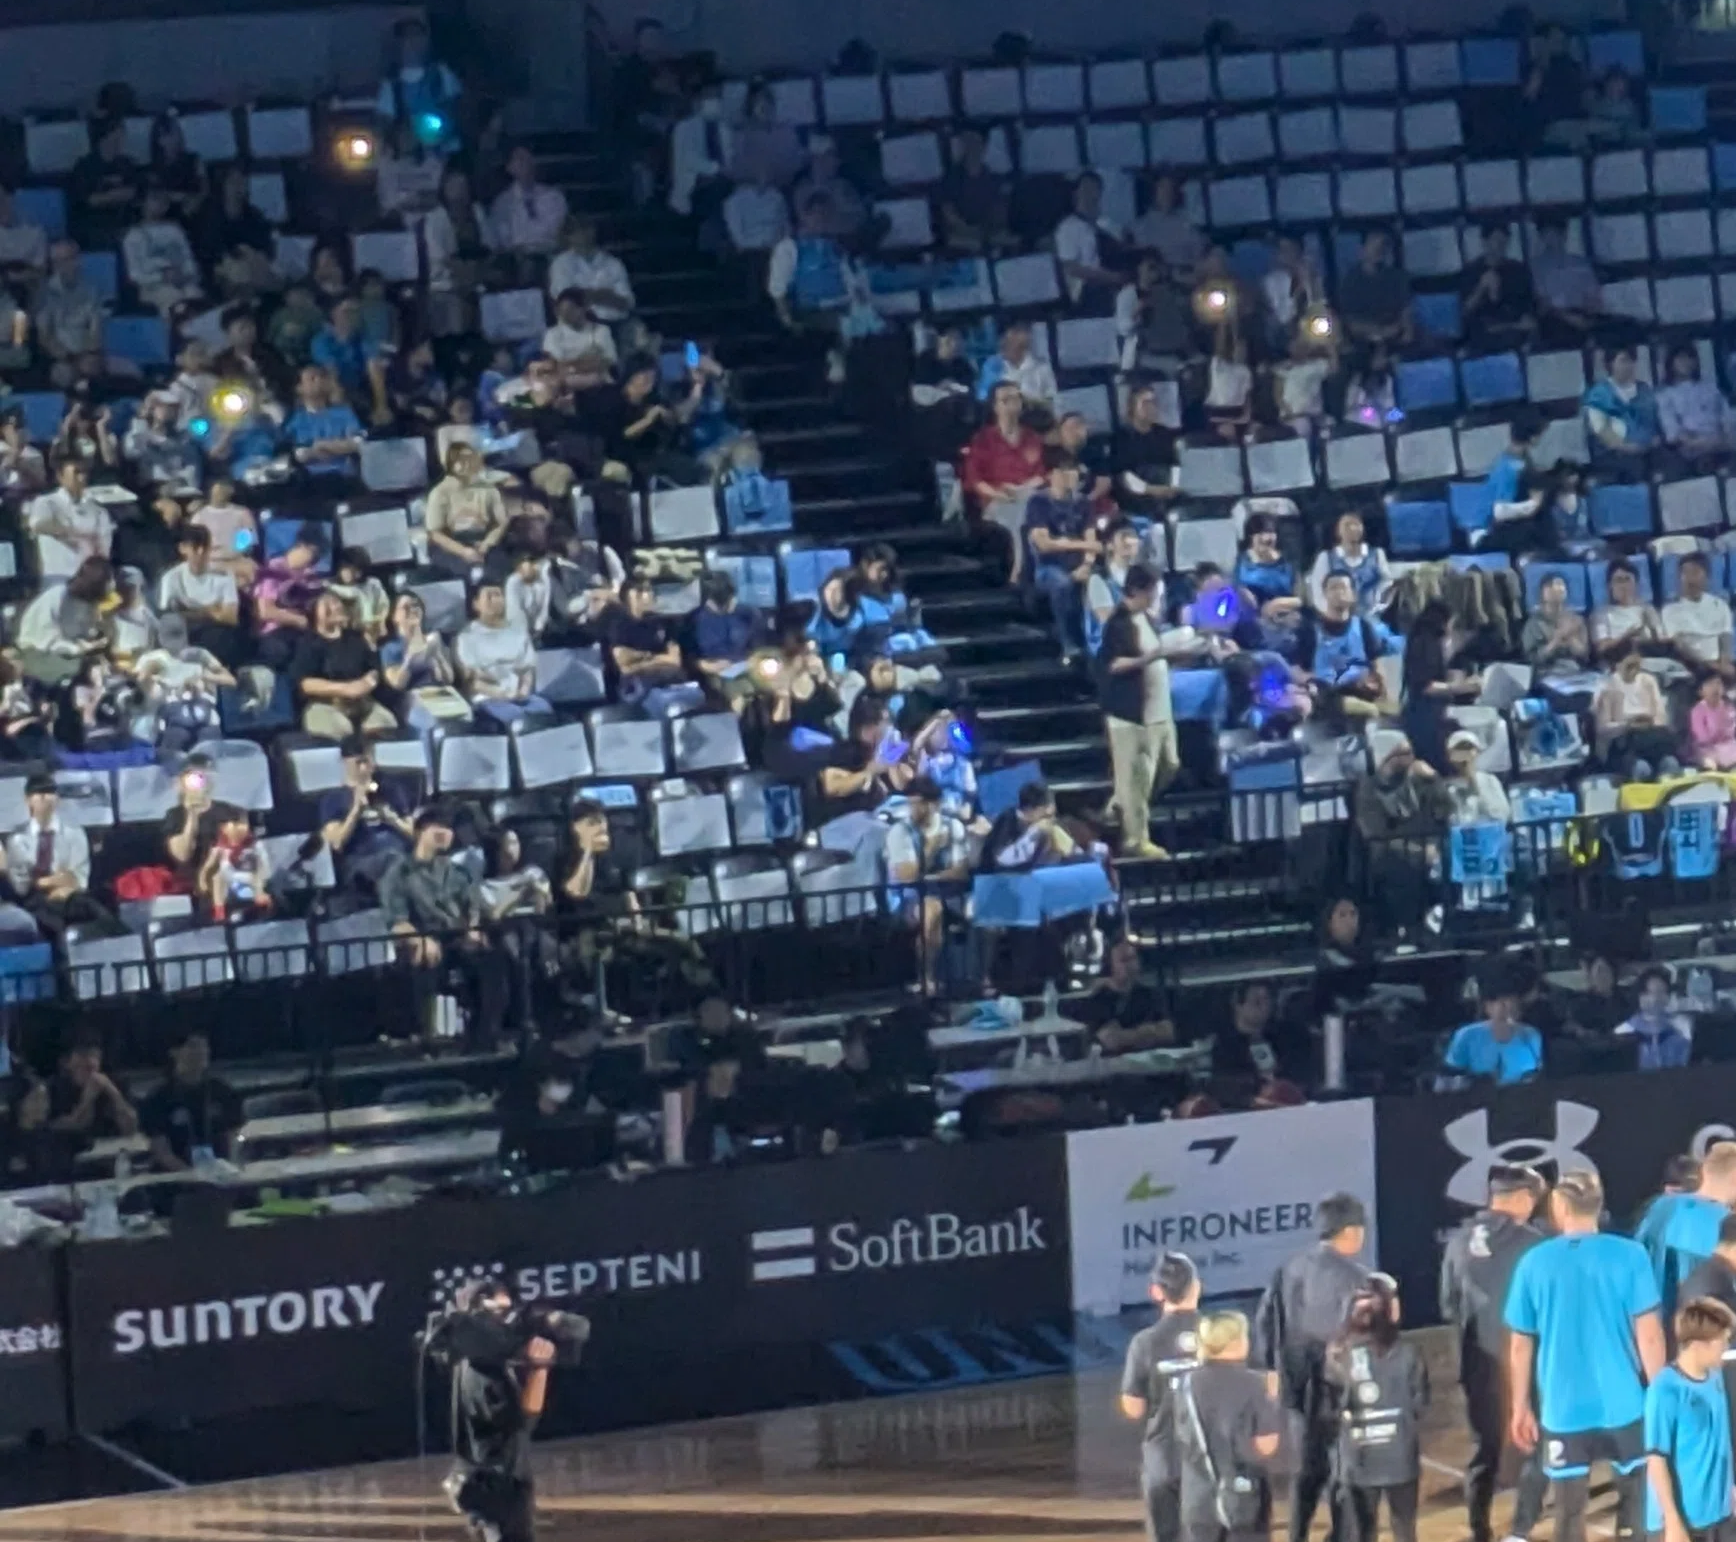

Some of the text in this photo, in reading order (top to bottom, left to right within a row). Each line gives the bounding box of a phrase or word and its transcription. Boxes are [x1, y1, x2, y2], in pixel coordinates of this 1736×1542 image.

[828, 1206, 1047, 1273] SoftBank
[1122, 1202, 1313, 1250] INFRONEER
[517, 1250, 701, 1301] SEPTENI
[113, 1280, 385, 1353] SUNTORY
